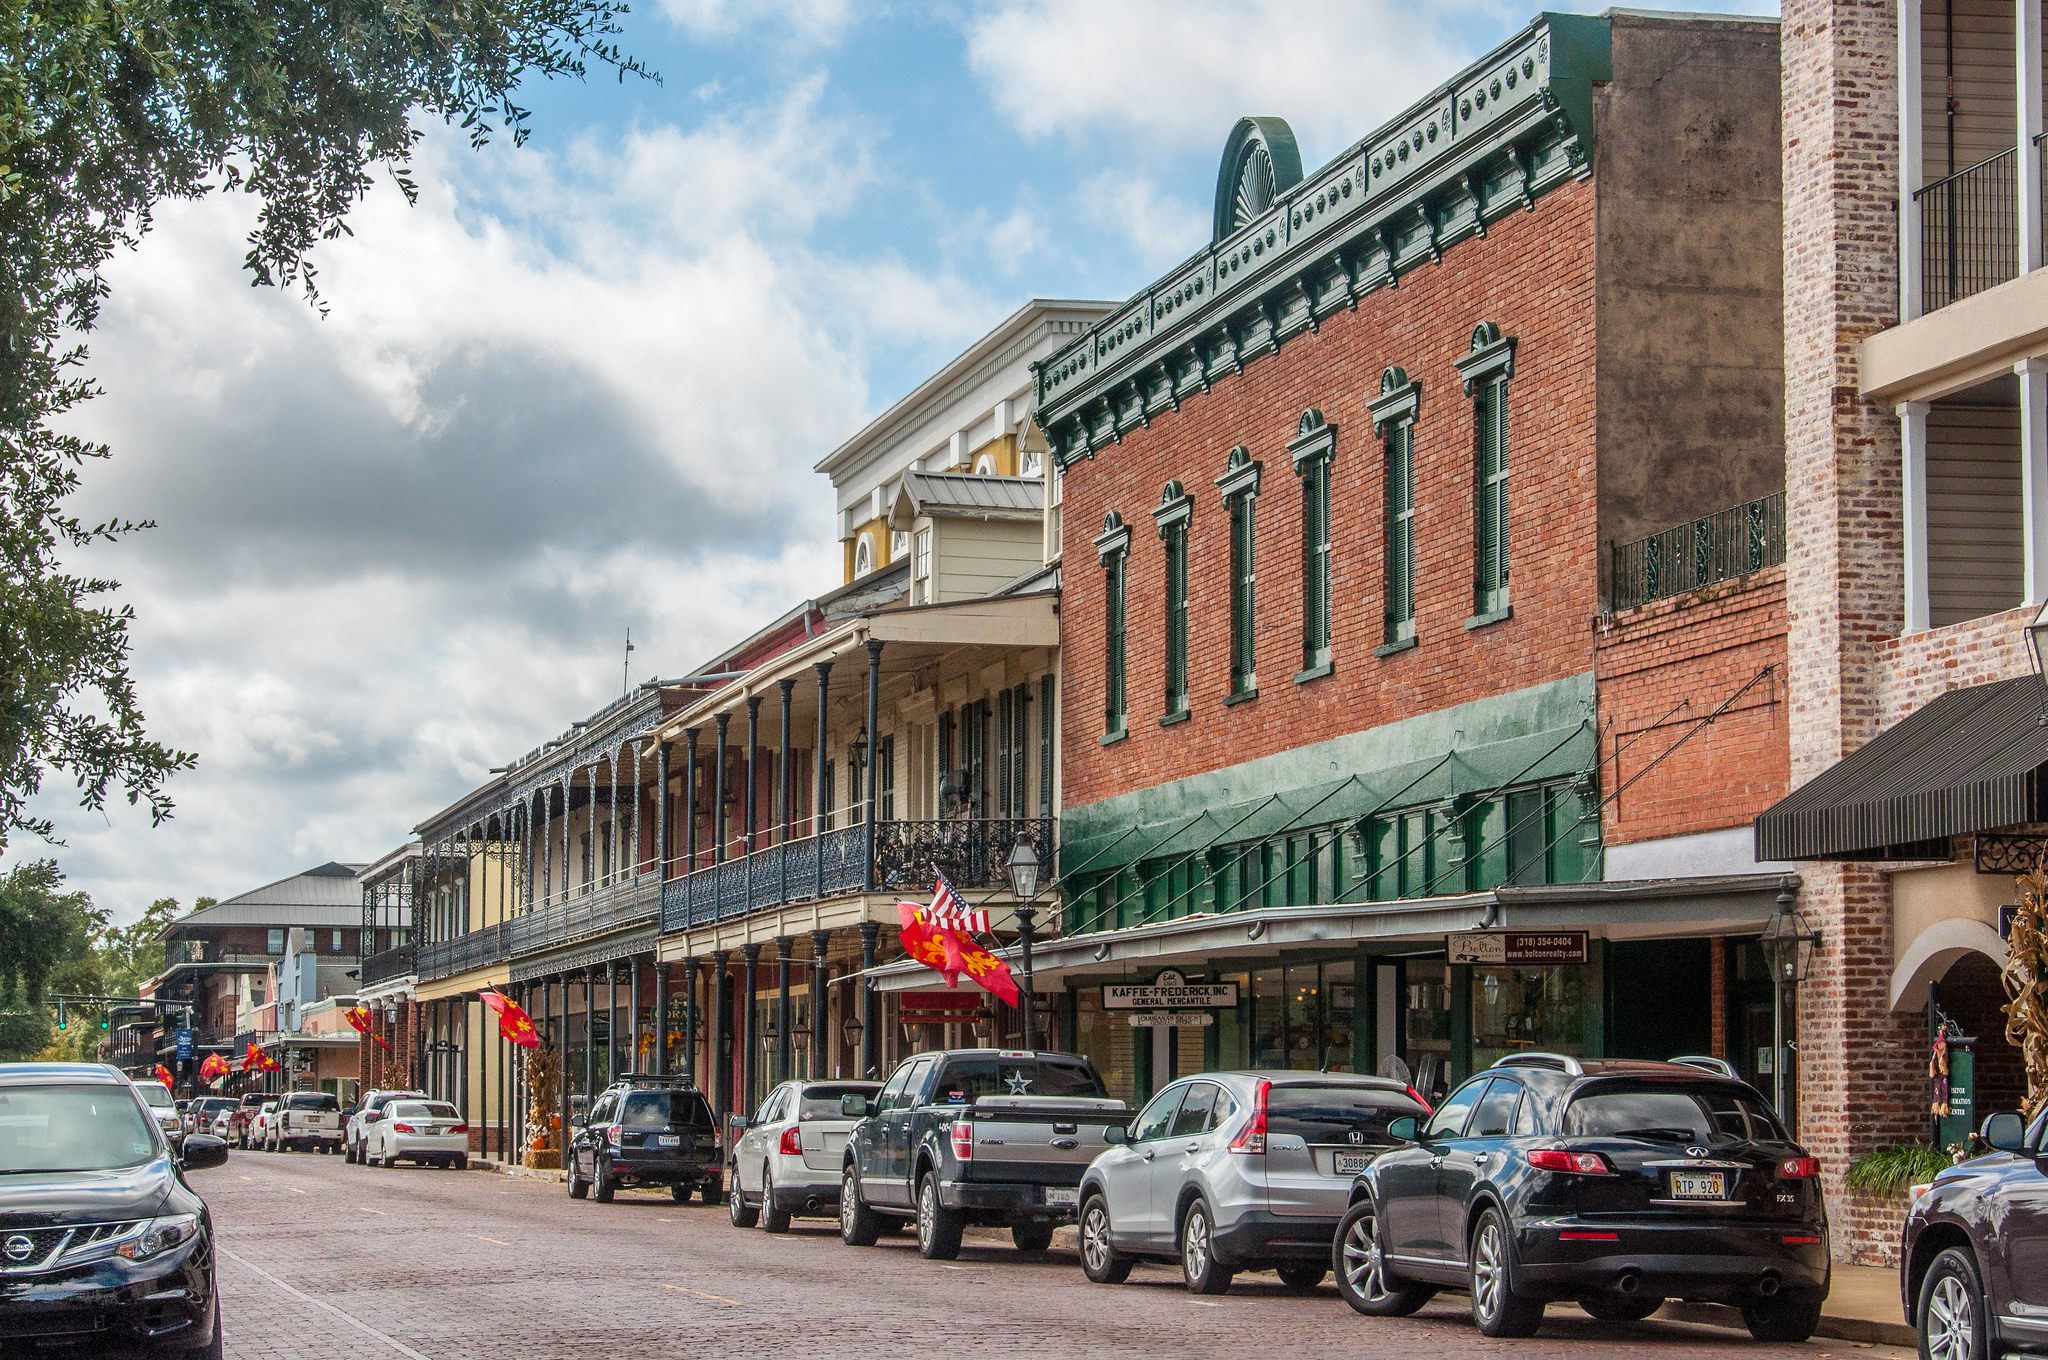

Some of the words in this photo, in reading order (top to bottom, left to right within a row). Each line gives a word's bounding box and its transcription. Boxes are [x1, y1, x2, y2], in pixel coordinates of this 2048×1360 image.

[1453, 940, 1504, 953] Bolton
[1516, 937, 1536, 948] (318)
[1537, 937, 1572, 946] 354-0404
[1507, 949, 1582, 959] www.boltonrealty.com
[1132, 998, 1164, 1006] GENERAL
[1167, 997, 1211, 1005] MERCANTILE
[1676, 1180, 1694, 1194] RTP
[1702, 1180, 1719, 1194] 920
